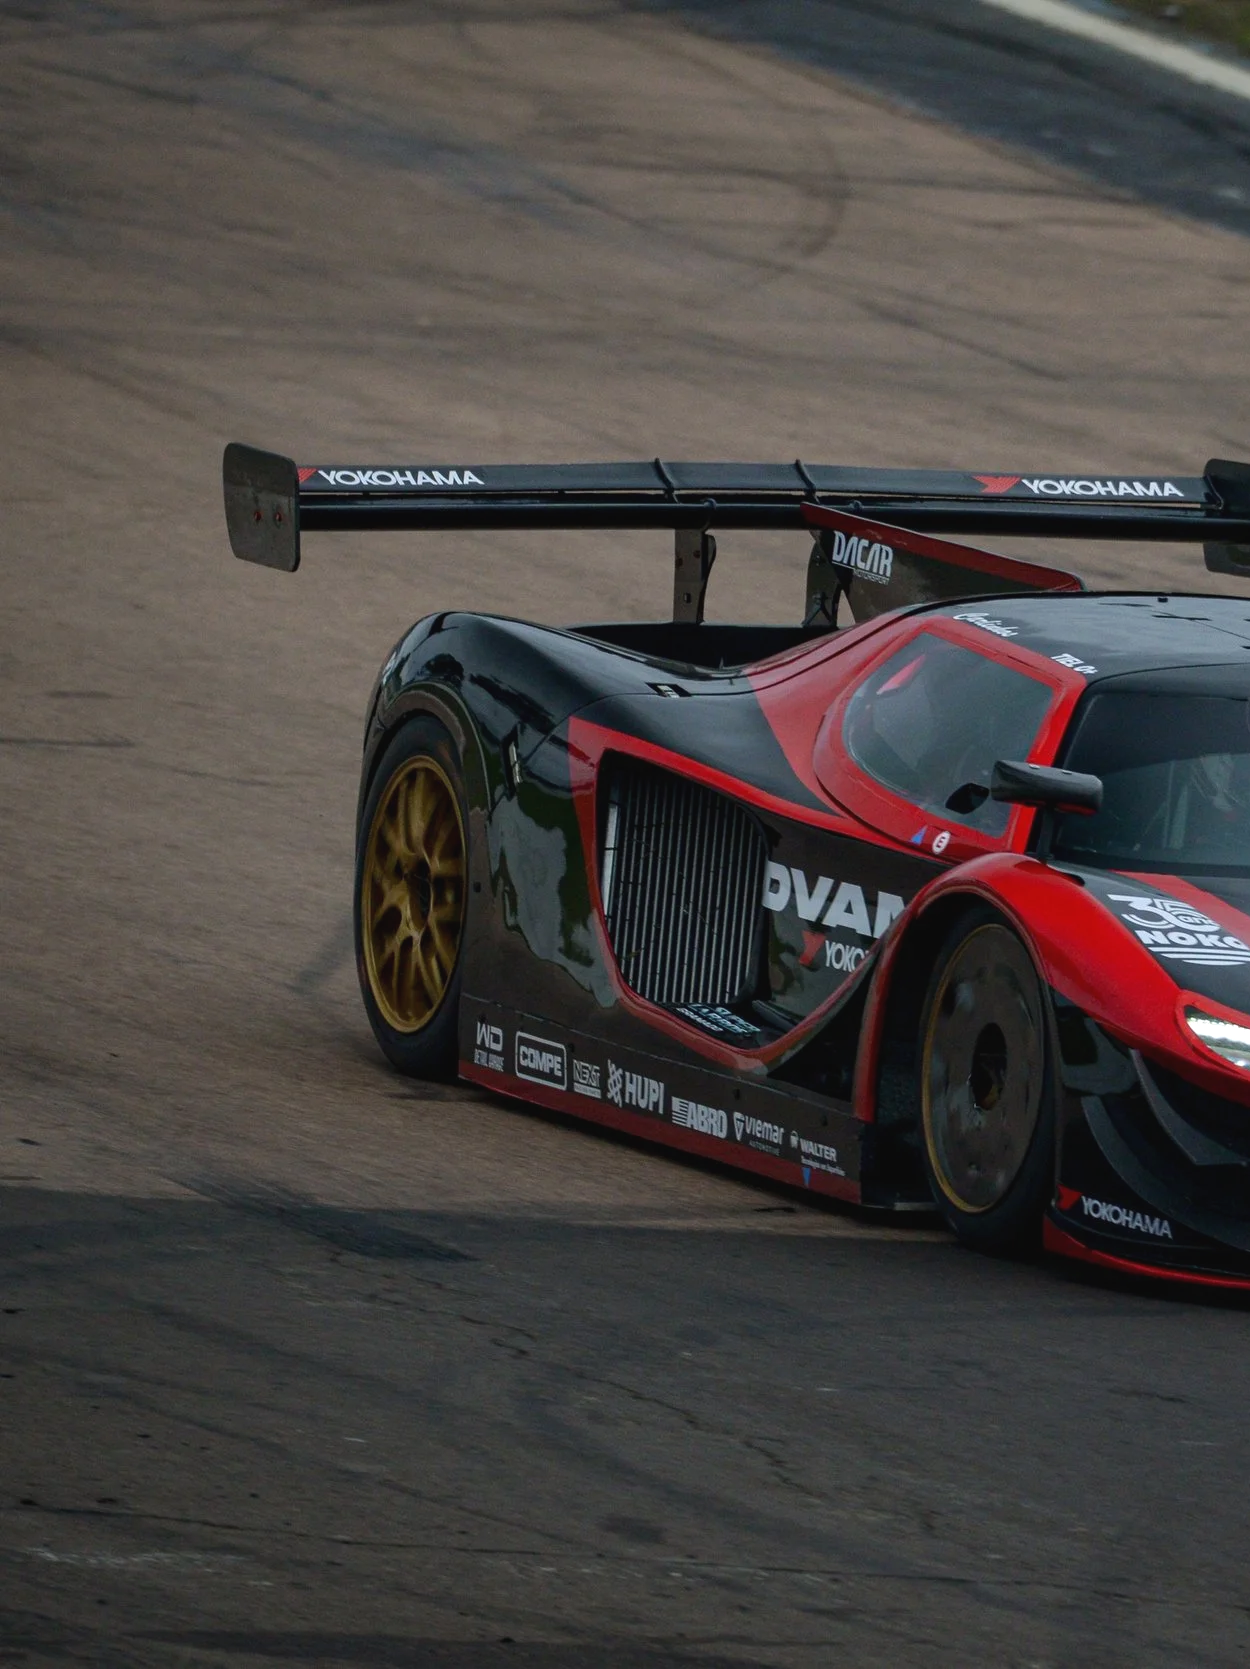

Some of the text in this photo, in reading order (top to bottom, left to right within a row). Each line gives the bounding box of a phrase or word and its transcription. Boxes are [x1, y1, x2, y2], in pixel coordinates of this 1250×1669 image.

[317, 470, 485, 486] YOKOHAMA
[1021, 478, 1184, 498] YOKOHAMA
[832, 530, 894, 577] DACAR
[1134, 929, 1250, 950] NOKO
[825, 940, 870, 973] YOKO
[476, 1021, 503, 1052] WD
[519, 1044, 562, 1077] COMPE
[625, 1071, 665, 1115] HUPI
[686, 1100, 728, 1140] ABRO
[800, 1138, 837, 1162] WALTER
[1081, 1195, 1173, 1240] YOKOHAMA
